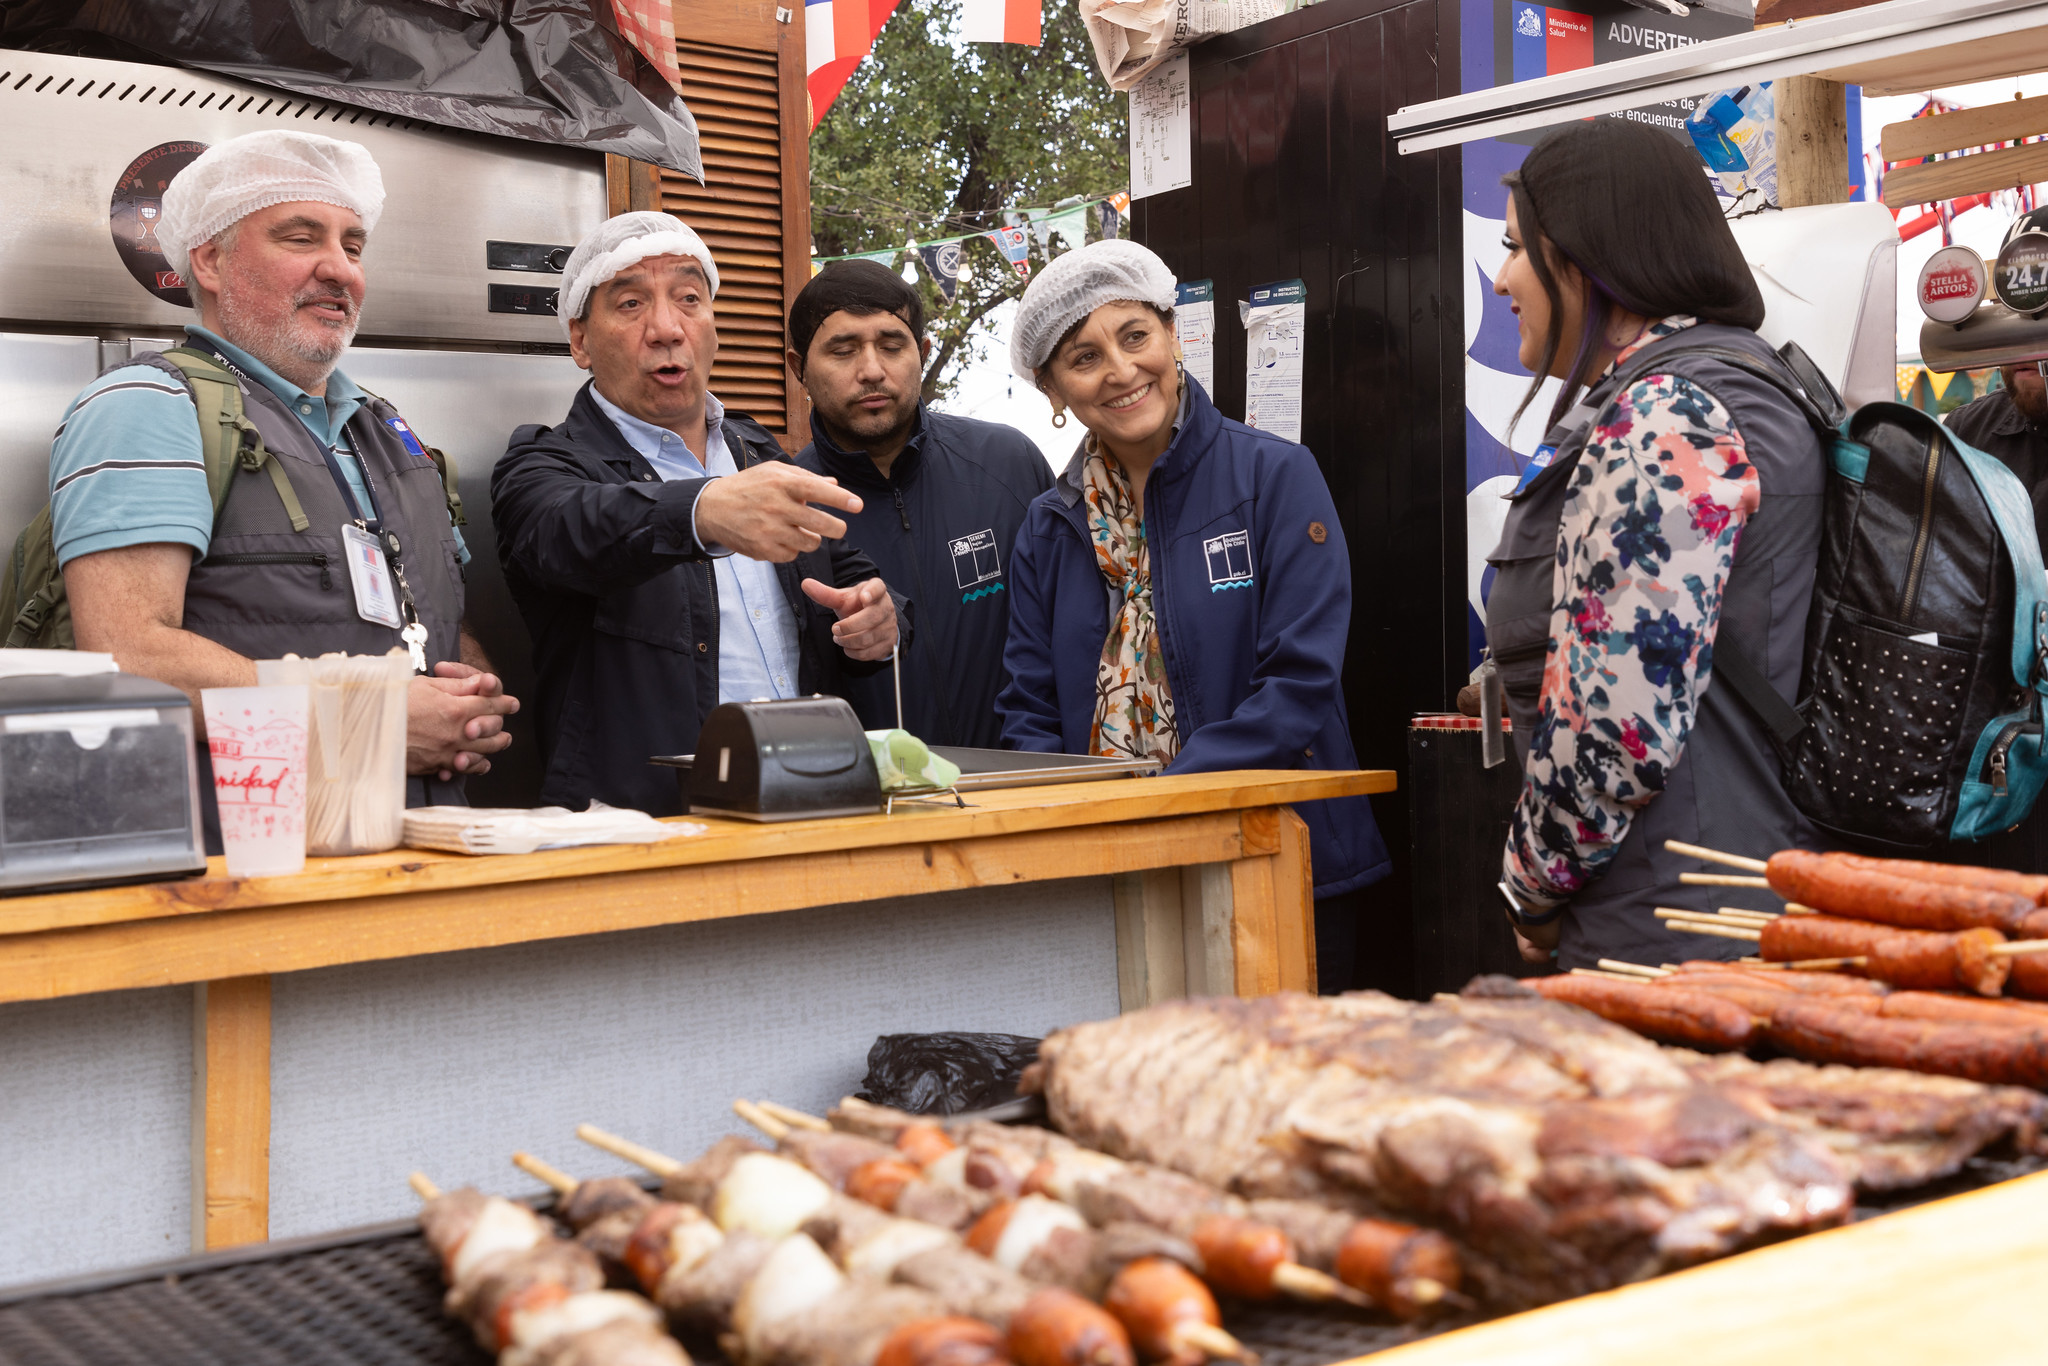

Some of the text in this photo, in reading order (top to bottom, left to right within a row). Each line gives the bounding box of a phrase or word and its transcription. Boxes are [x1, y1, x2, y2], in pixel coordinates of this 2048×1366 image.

[1549, 18, 1587, 32] Ministerio de
[1549, 28, 1566, 38] Salud
[1608, 22, 1707, 51] ADVERTEN
[1680, 97, 1695, 111] de
[119, 147, 168, 191] PRESENTE
[1930, 274, 1967, 287] STELLA
[2006, 264, 2048, 289] 24.7
[1930, 283, 1968, 297] ARTOIS
[1225, 535, 1246, 543] Gobierno
[214, 764, 289, 803] nidad
